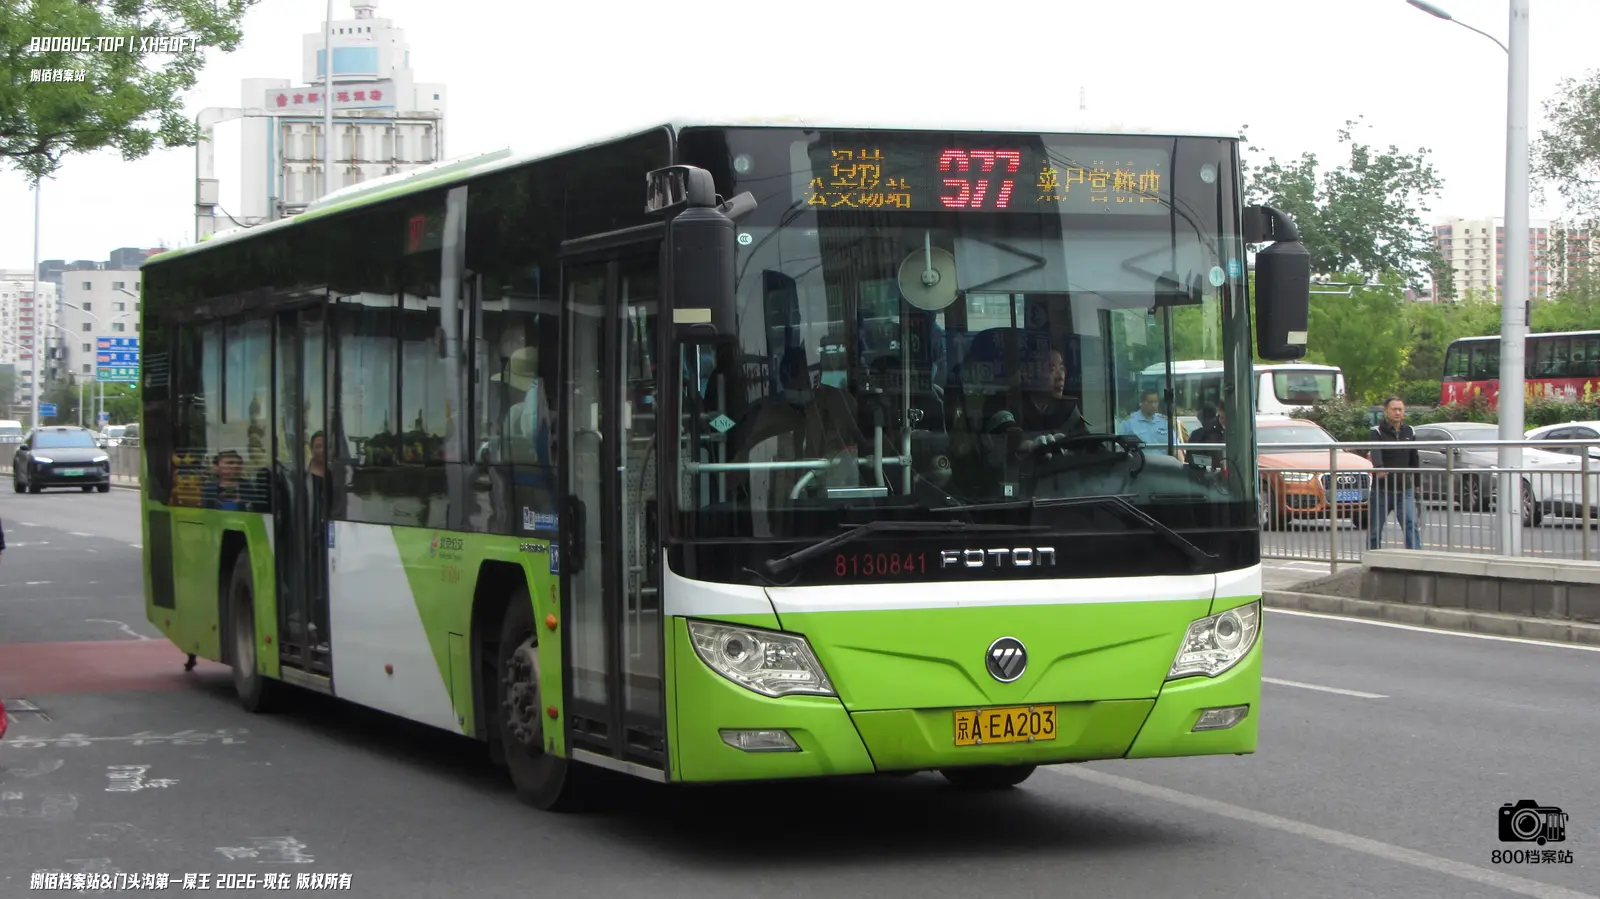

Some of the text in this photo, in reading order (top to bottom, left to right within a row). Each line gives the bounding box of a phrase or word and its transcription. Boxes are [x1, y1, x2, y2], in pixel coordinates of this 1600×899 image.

[938, 150, 1020, 208] 977
[834, 547, 1056, 577] 8130841 FOTON
